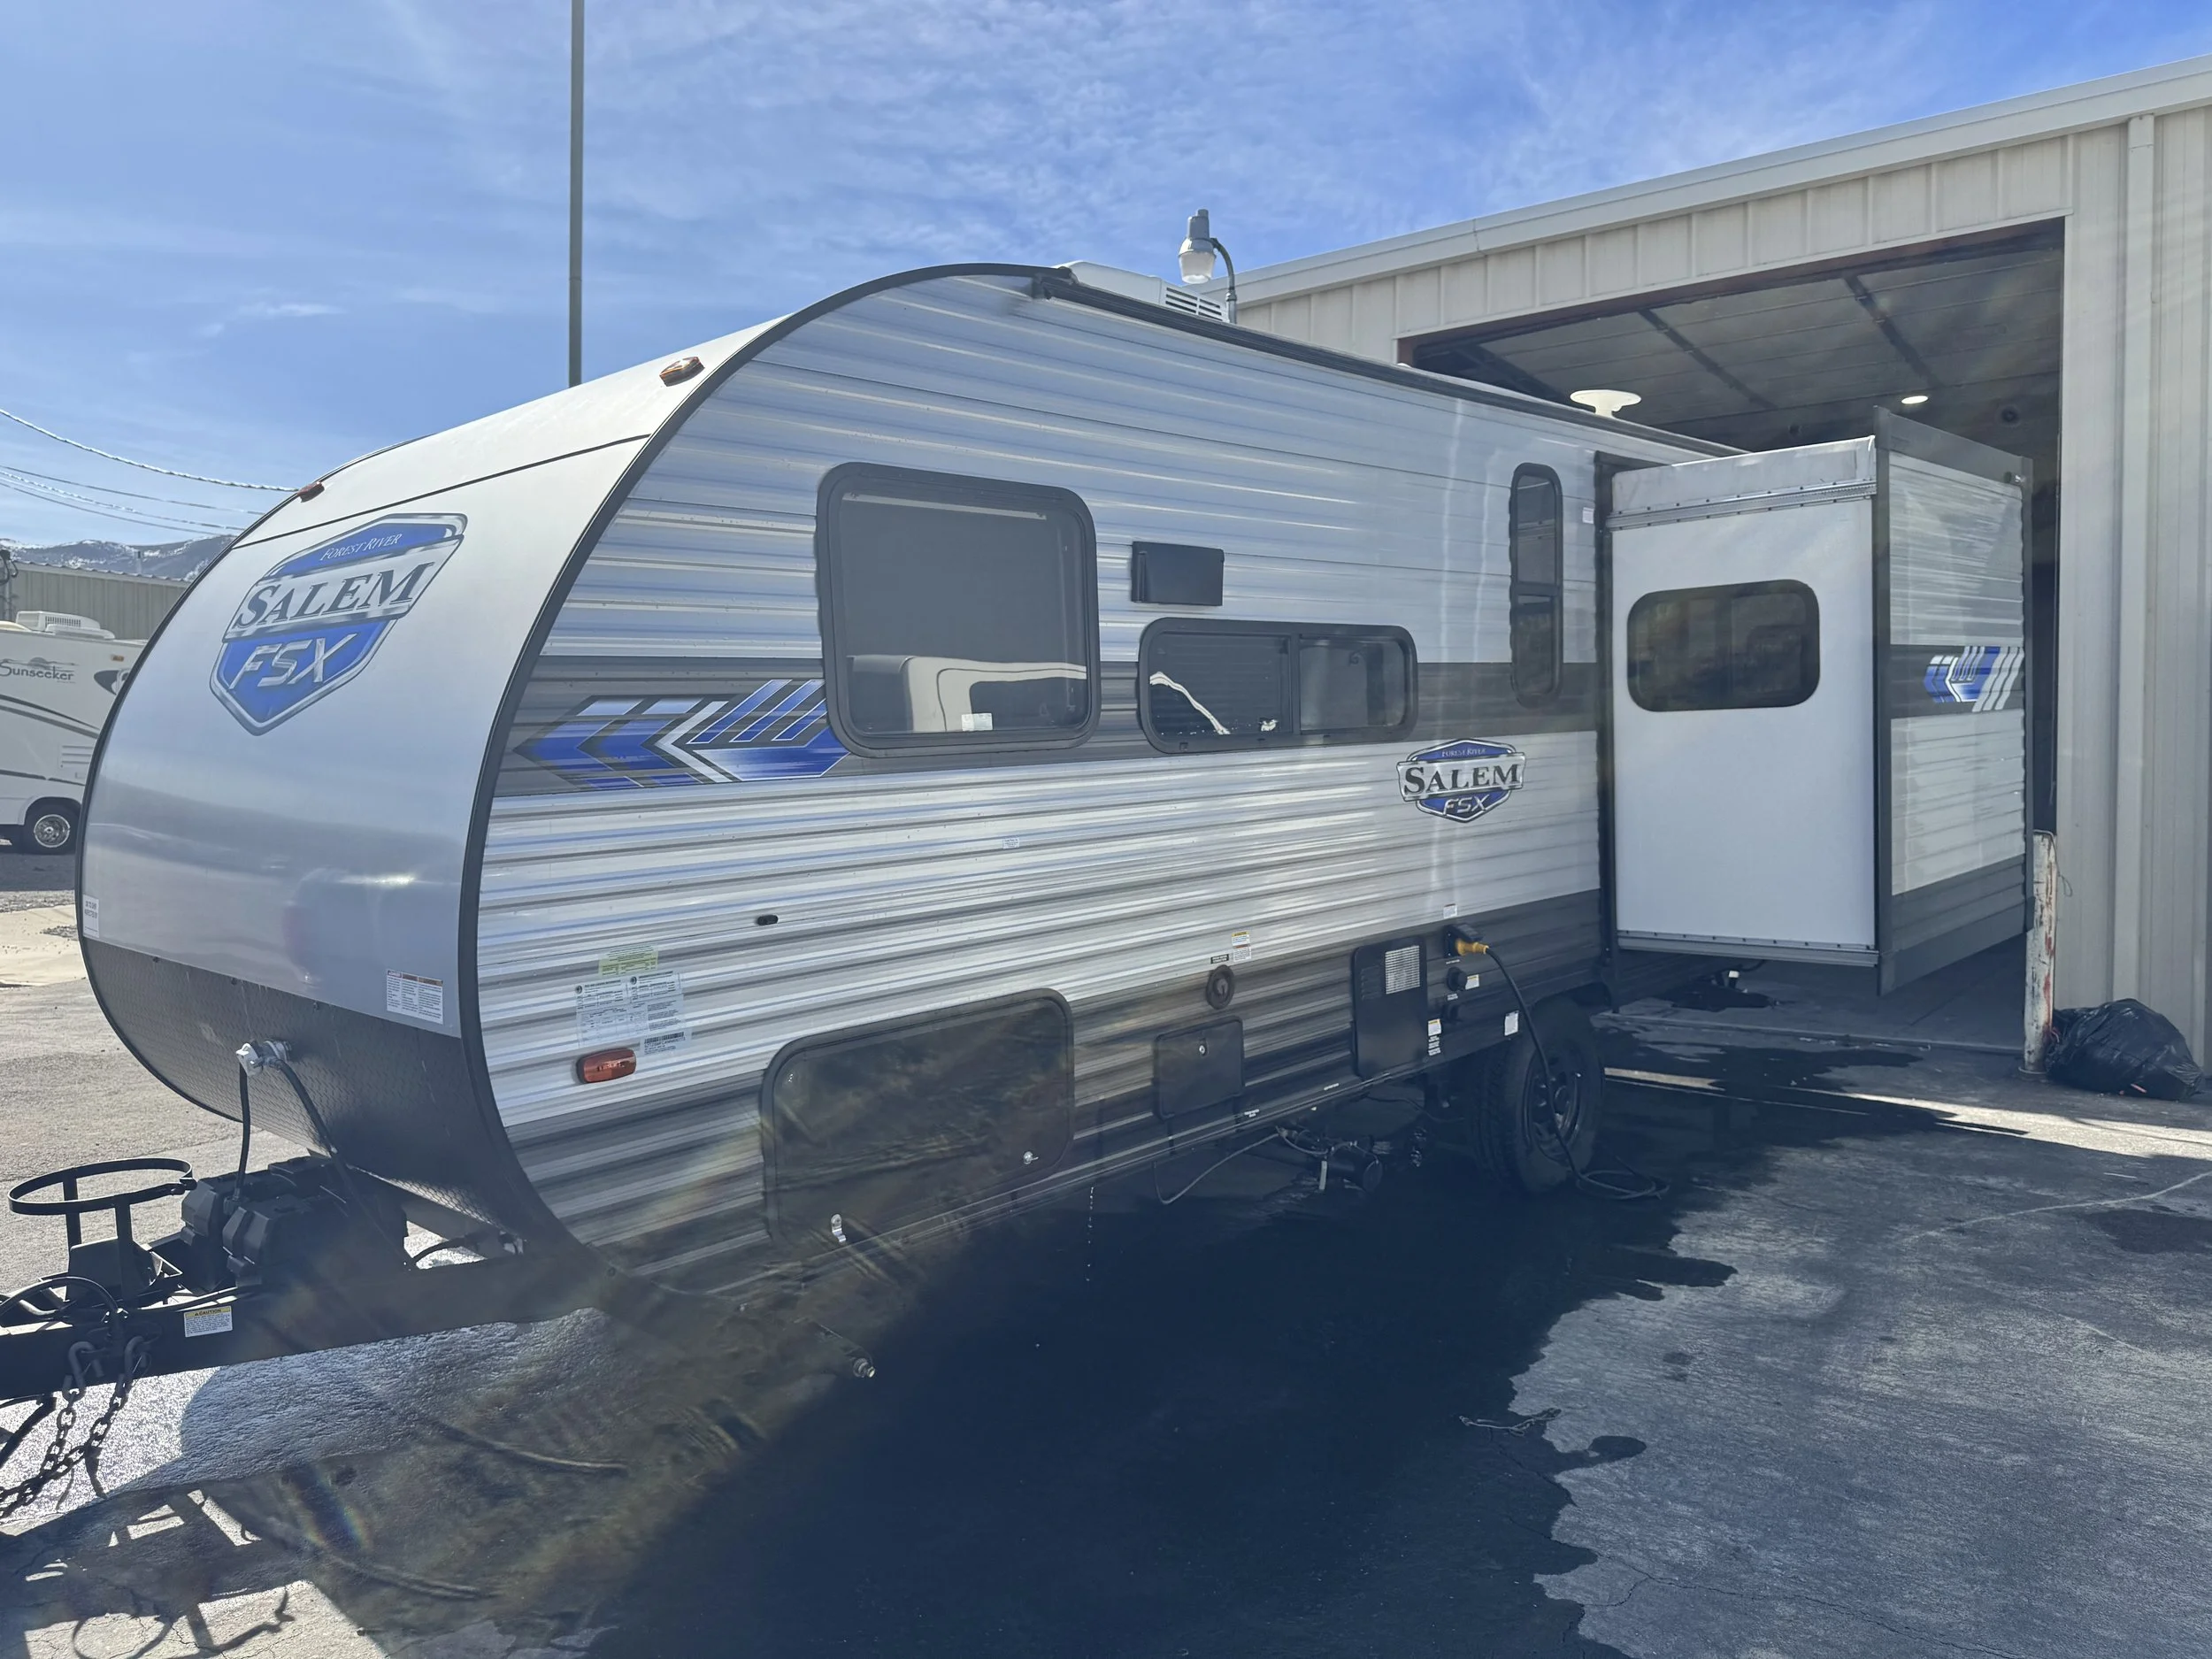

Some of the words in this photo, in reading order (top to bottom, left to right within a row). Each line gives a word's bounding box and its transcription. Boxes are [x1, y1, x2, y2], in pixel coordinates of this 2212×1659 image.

[319, 542, 366, 561] FOREST
[364, 534, 403, 551] RIVER
[231, 561, 435, 630] SALEM
[0, 662, 74, 680] Sunseeker
[228, 634, 357, 689] FSX
[1404, 764, 1520, 795] SALEM
[1443, 794, 1490, 815] FSX
